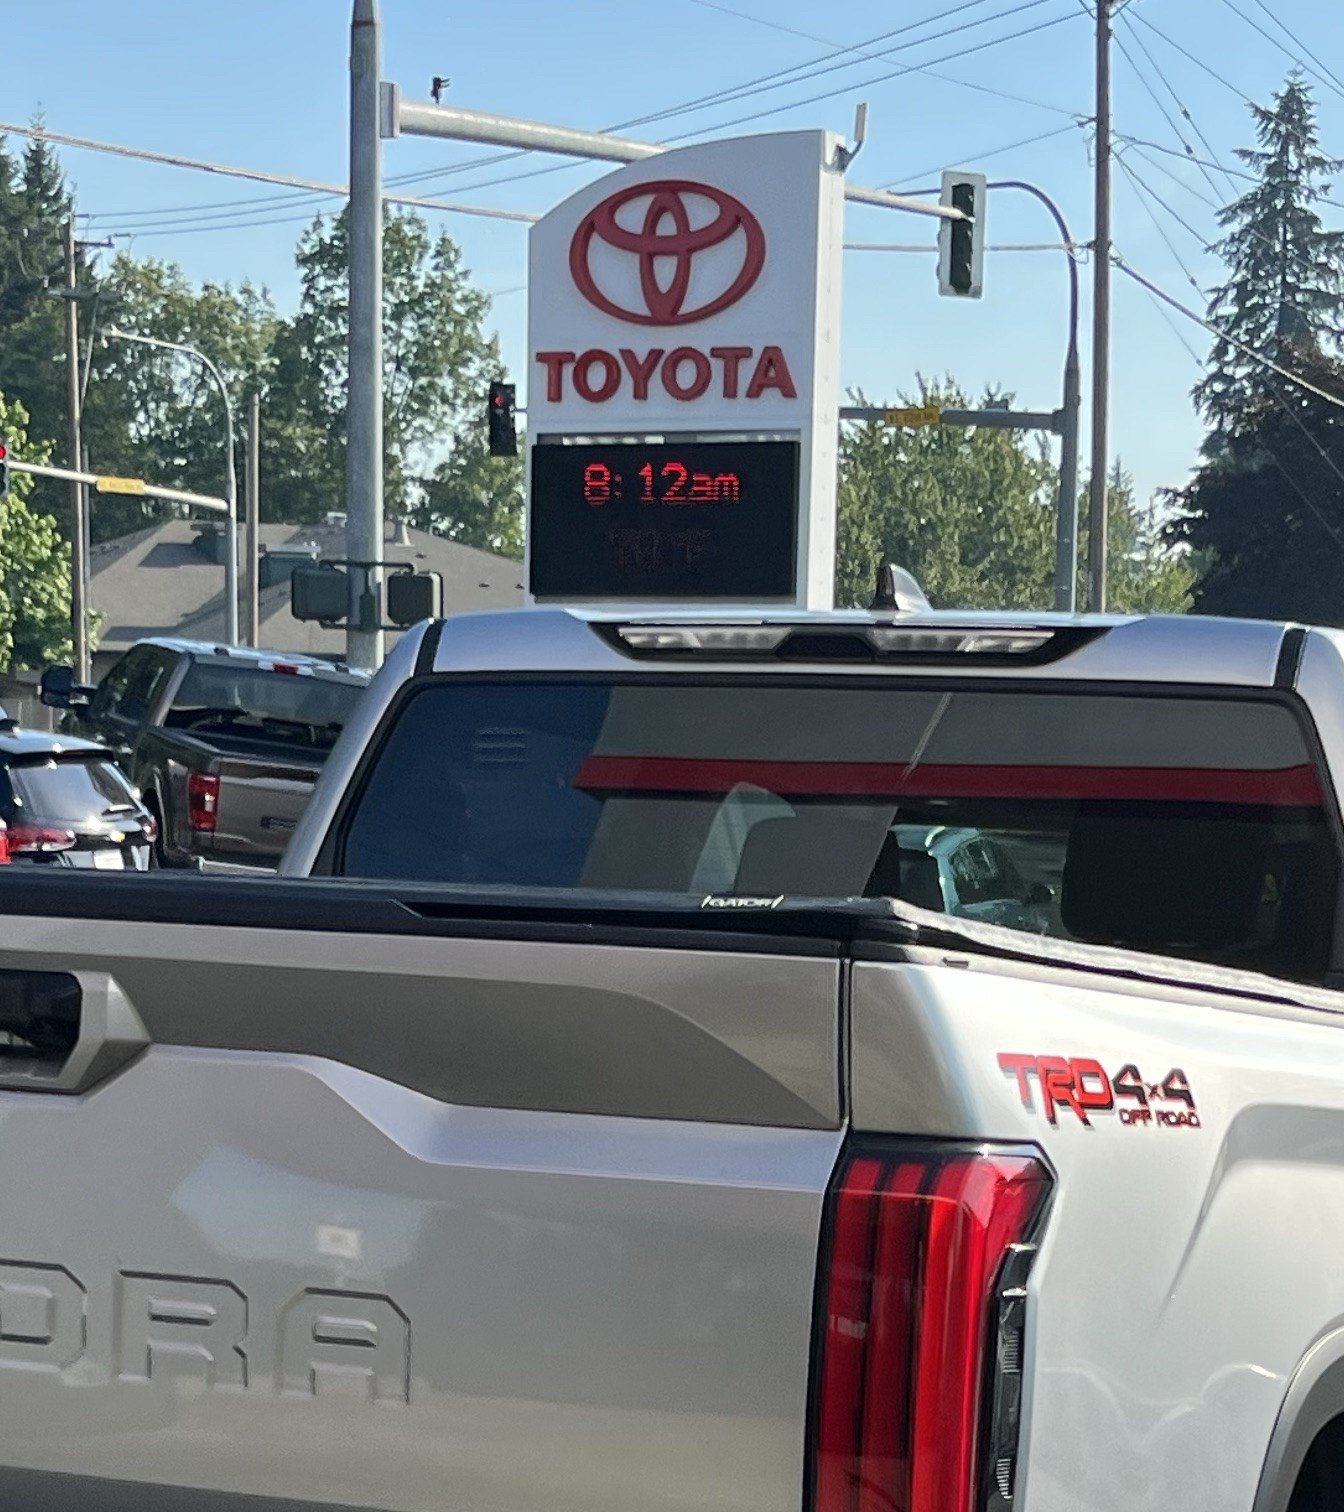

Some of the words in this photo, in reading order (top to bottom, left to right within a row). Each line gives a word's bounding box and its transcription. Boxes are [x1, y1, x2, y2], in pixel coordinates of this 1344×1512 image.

[535, 345, 798, 402] TOYOTA
[996, 1052, 1115, 1127] TRD
[1112, 1063, 1197, 1110] 4x4
[1118, 1107, 1153, 1127] OFF
[1156, 1109, 1202, 1129] ROAD
